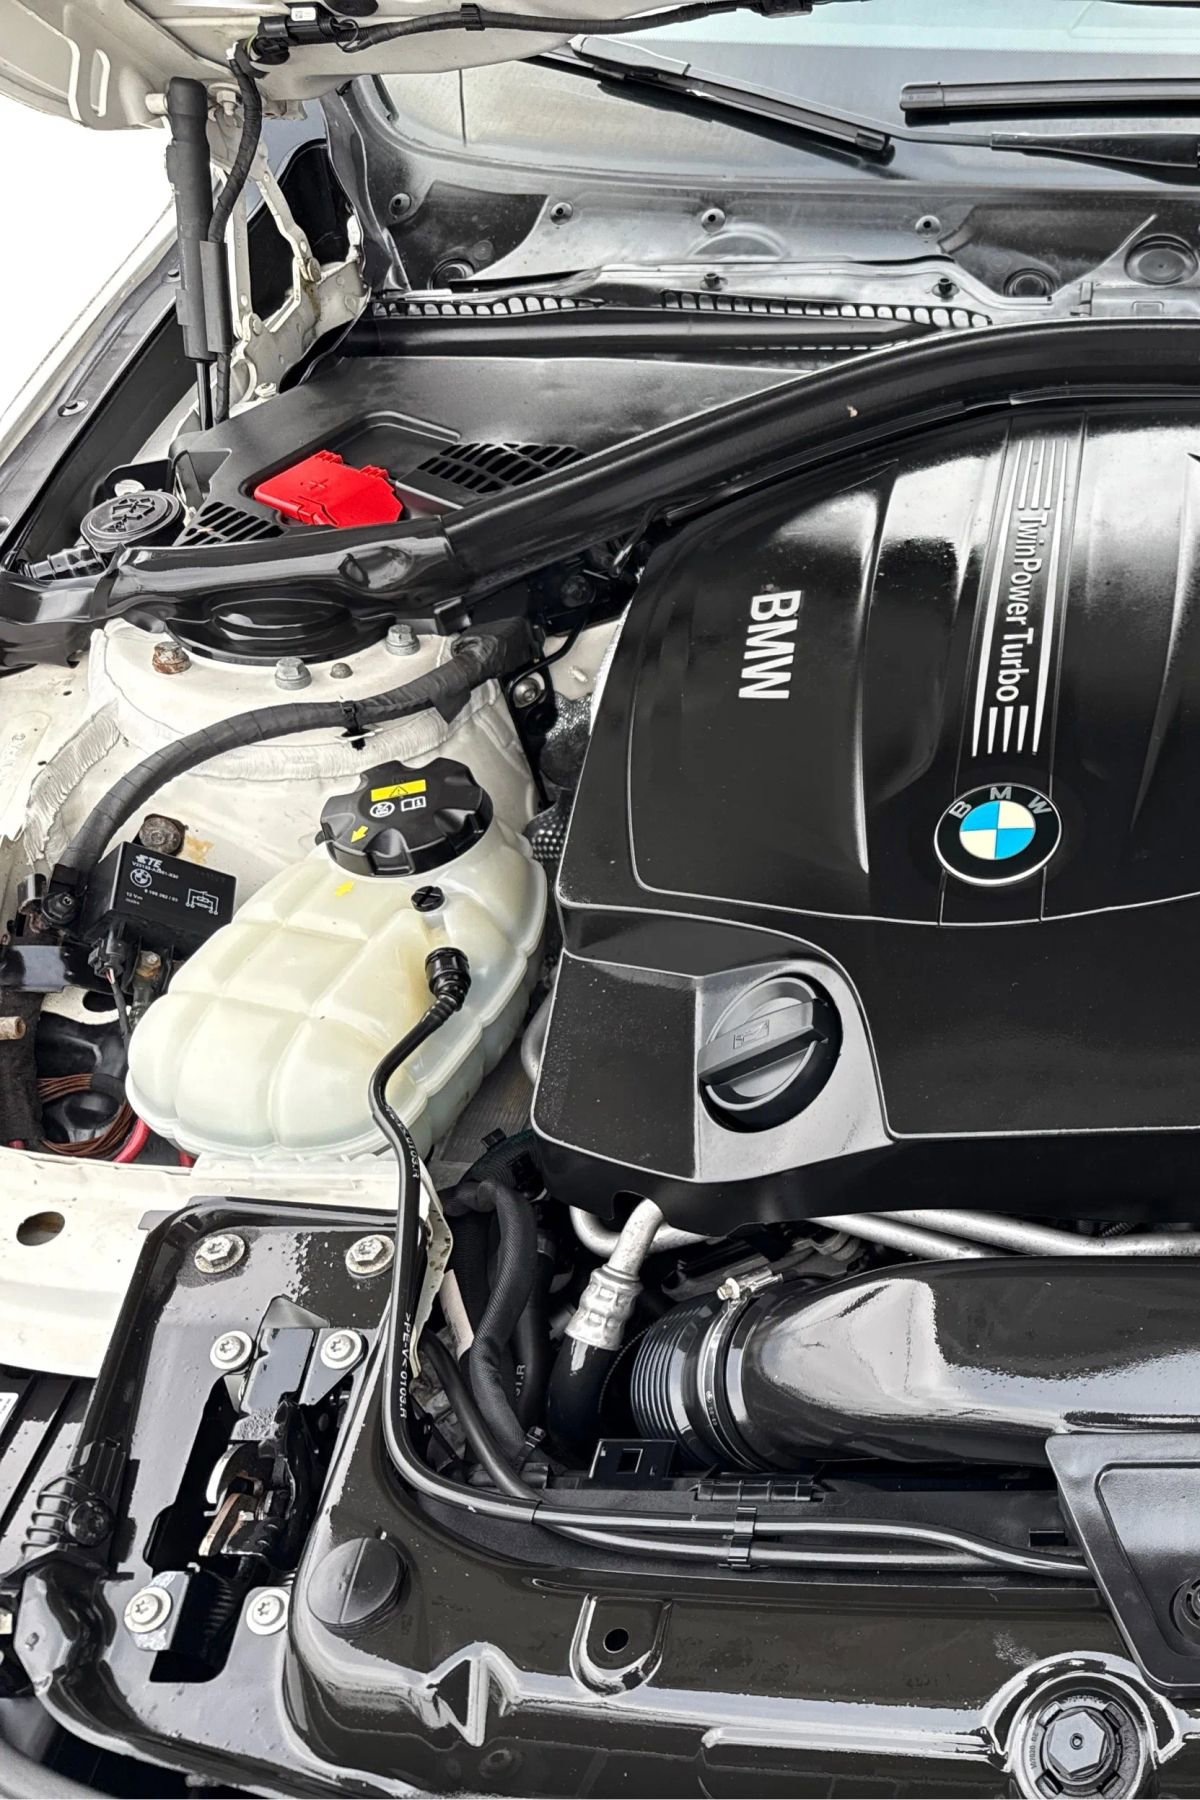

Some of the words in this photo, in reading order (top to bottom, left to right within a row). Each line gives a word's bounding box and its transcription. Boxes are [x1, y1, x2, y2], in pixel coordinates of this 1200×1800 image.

[1004, 507, 1048, 626] TwinPower
[738, 589, 802, 700] BMW
[995, 627, 1034, 703] Turbo
[948, 785, 1054, 819] BMW
